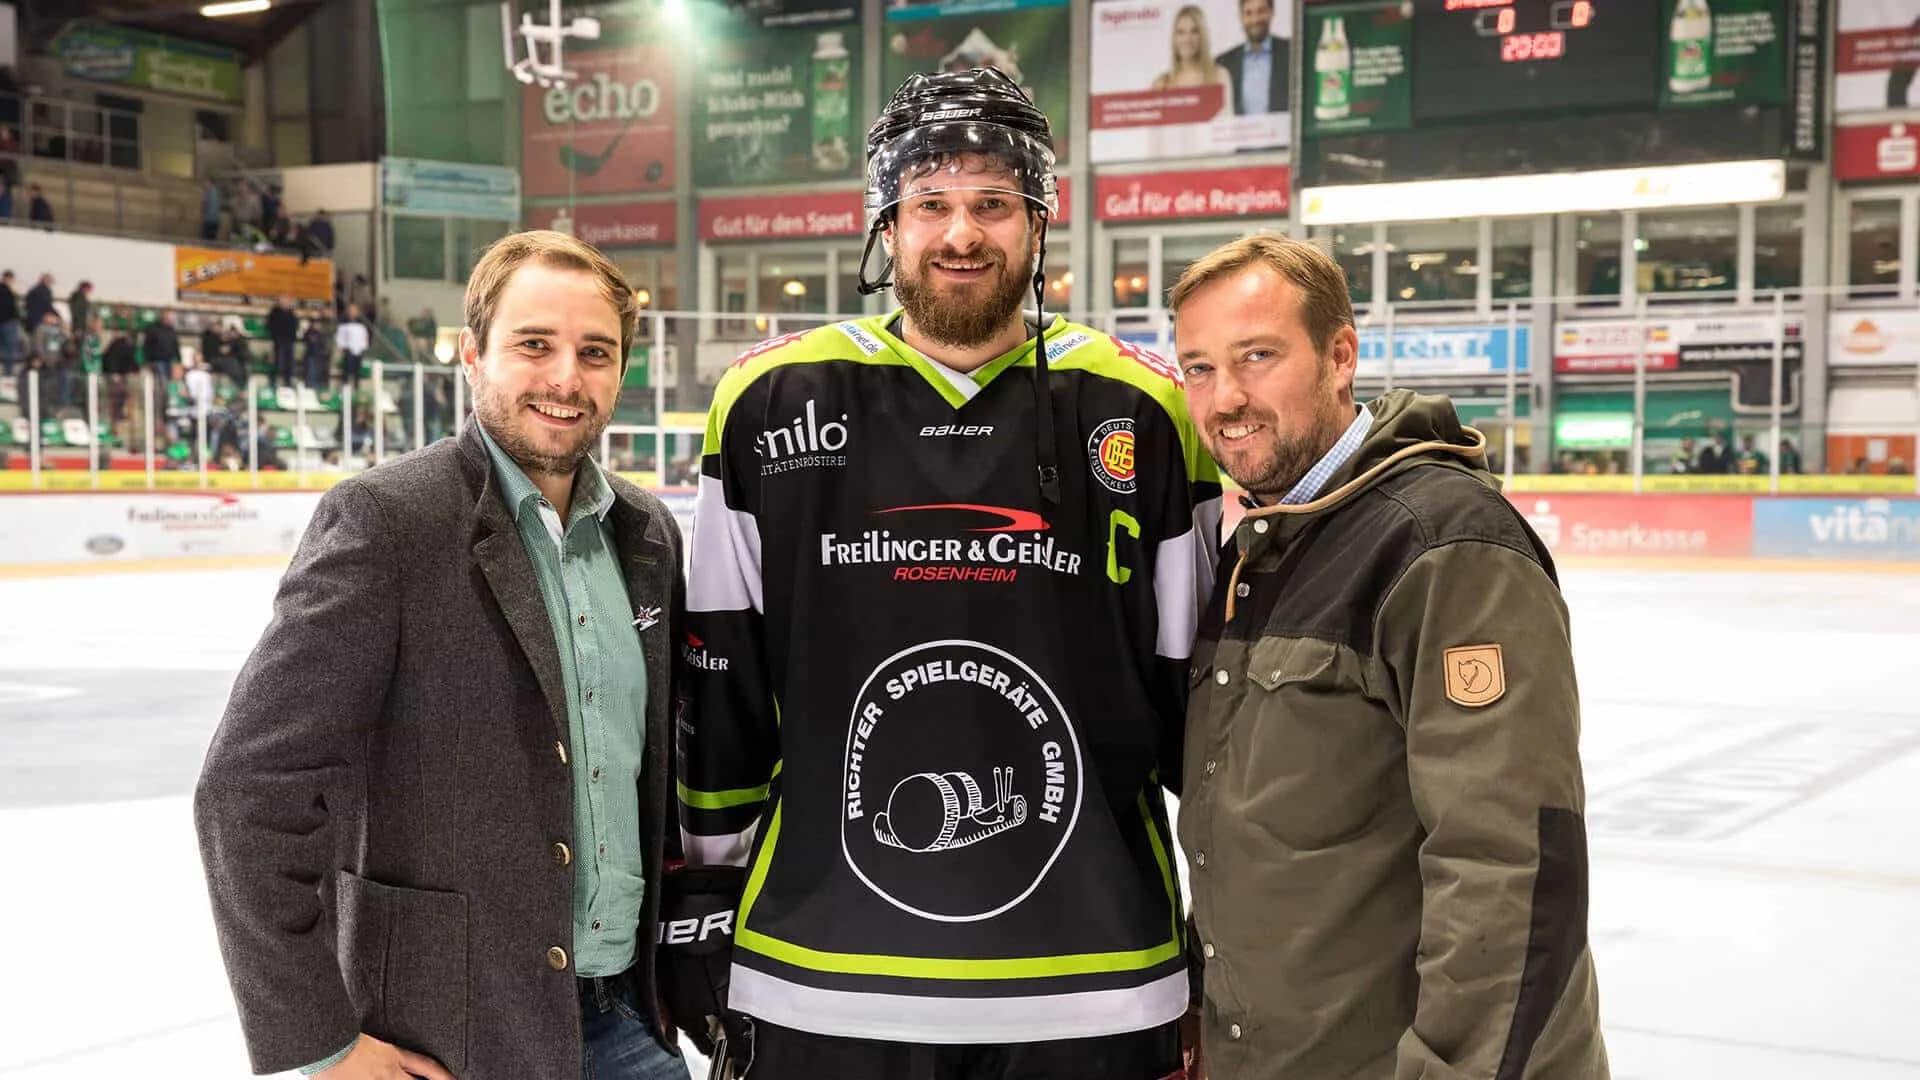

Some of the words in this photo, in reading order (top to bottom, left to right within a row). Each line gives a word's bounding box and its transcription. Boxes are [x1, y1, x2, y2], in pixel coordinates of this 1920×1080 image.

[1497, 8, 1515, 33] 0
[1571, 1, 1591, 27] 0
[1502, 31, 1563, 61] 20:00
[544, 73, 660, 123] echo
[919, 107, 984, 122] BAUER
[1105, 194, 1140, 216] Gut
[1142, 191, 1171, 214] für
[1174, 190, 1207, 213] die
[1209, 187, 1288, 215] Region.
[712, 215, 742, 237] Gut
[744, 213, 769, 235] für
[771, 212, 805, 234] den
[806, 210, 855, 236] Sport
[919, 424, 994, 437] BAUER
[967, 540, 986, 562] &
[1106, 508, 1141, 585] C
[1570, 523, 1708, 552] Sparkasse
[893, 566, 1017, 583] ROSENHEIM
[847, 701, 884, 820] RICHTER
[885, 660, 1049, 730] SPIELGERÄTE
[1038, 740, 1065, 823] GMBH
